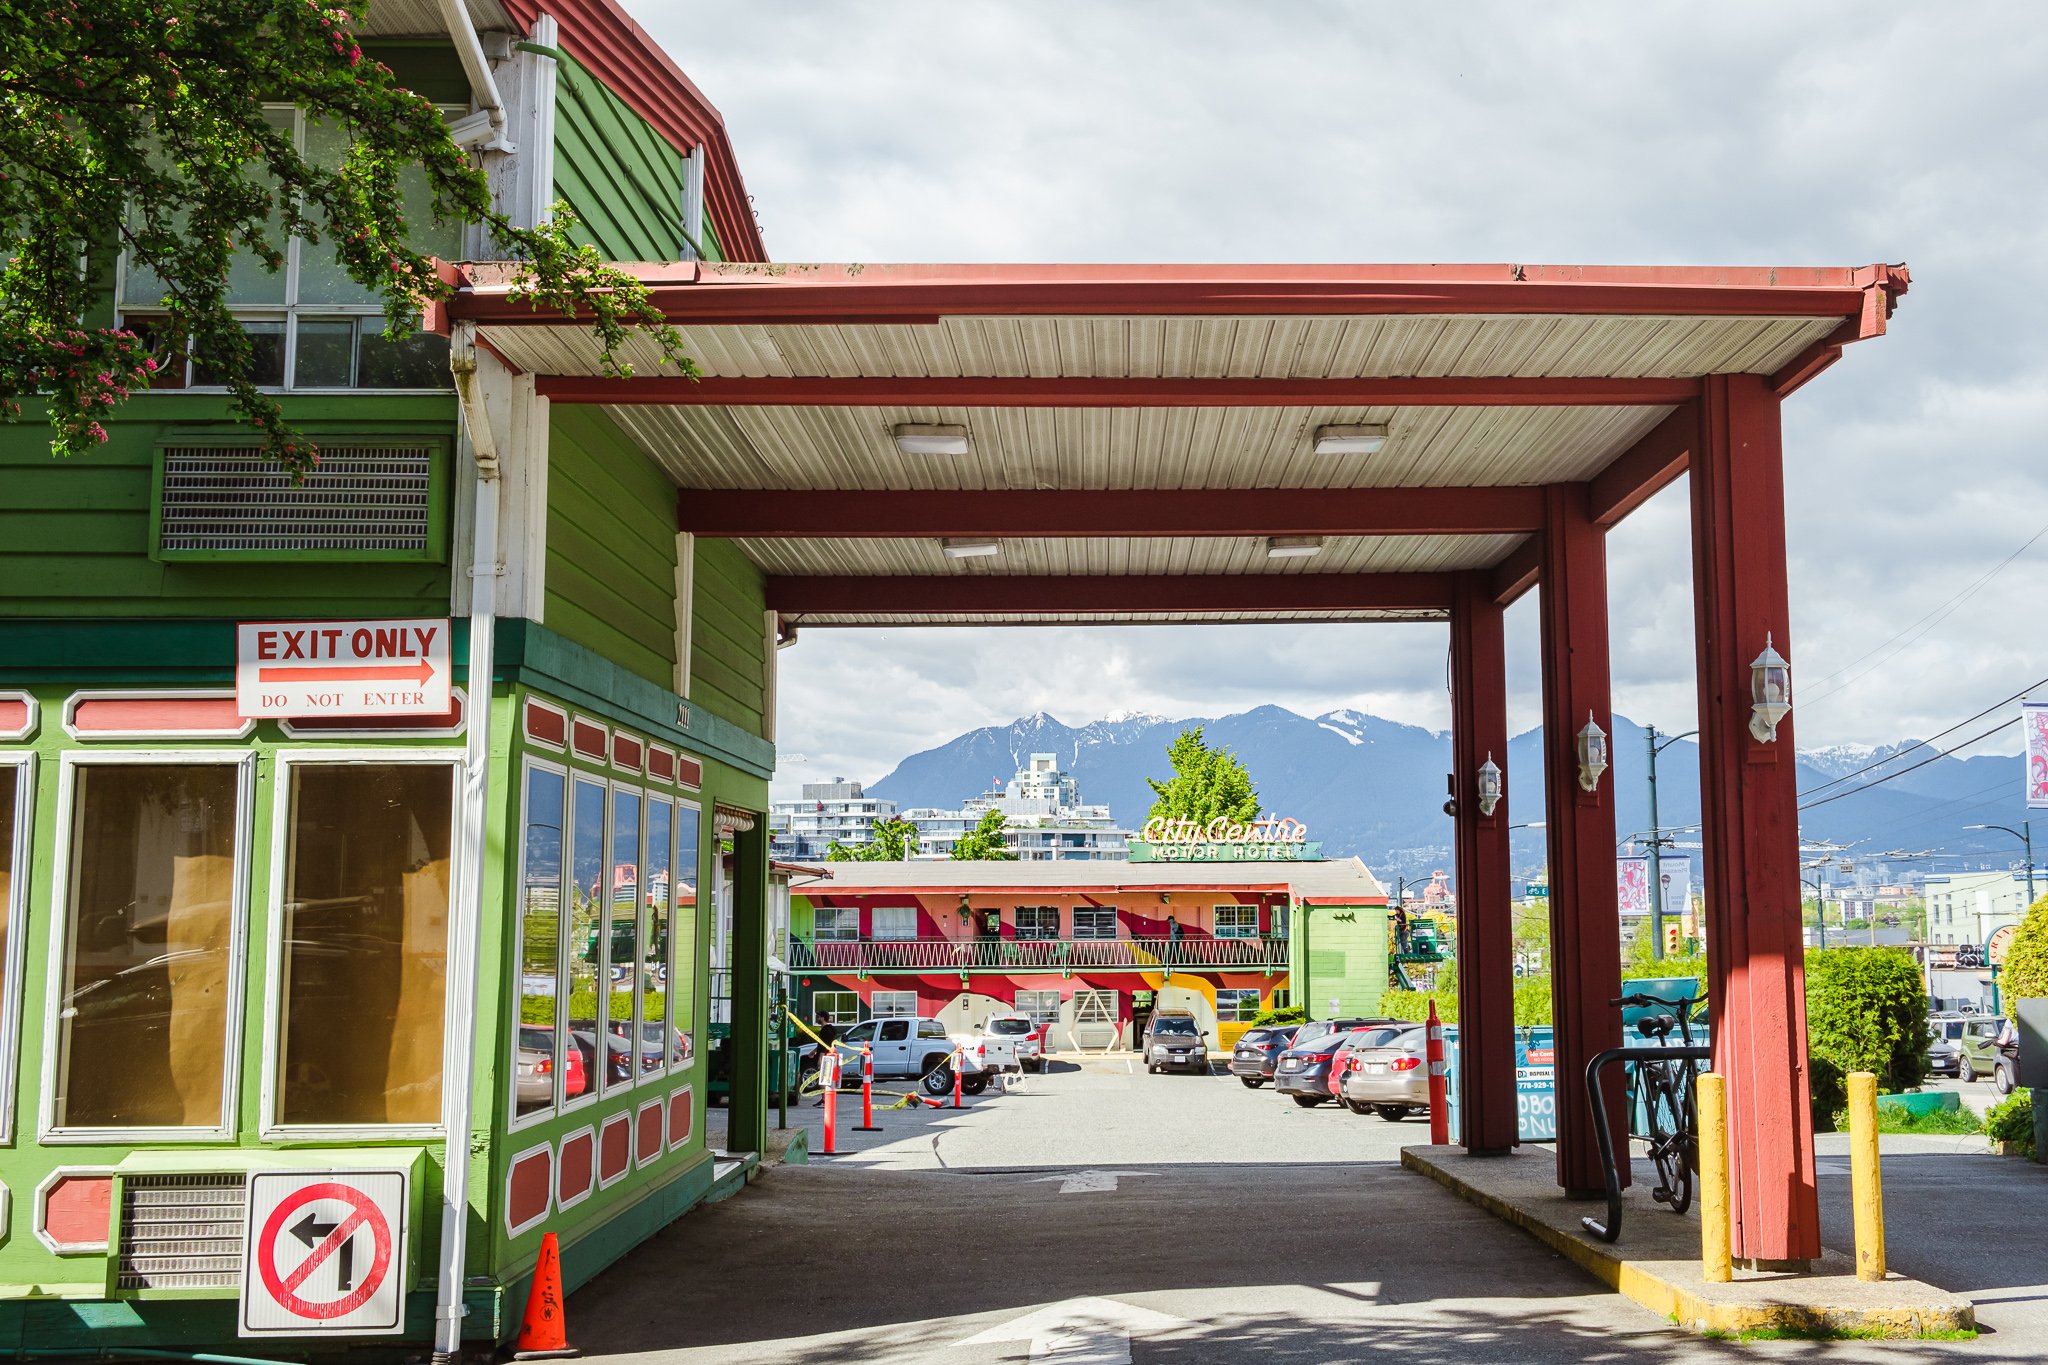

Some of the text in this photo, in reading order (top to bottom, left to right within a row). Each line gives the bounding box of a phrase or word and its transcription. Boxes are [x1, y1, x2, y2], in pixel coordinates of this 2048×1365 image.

[257, 627, 438, 660] EXIT ONLY
[261, 691, 425, 708] DO NOT ENTER
[677, 702, 690, 730] 2111
[1143, 812, 1308, 859] City Centre
[1152, 845, 1298, 860] MOTOR HOTEL
